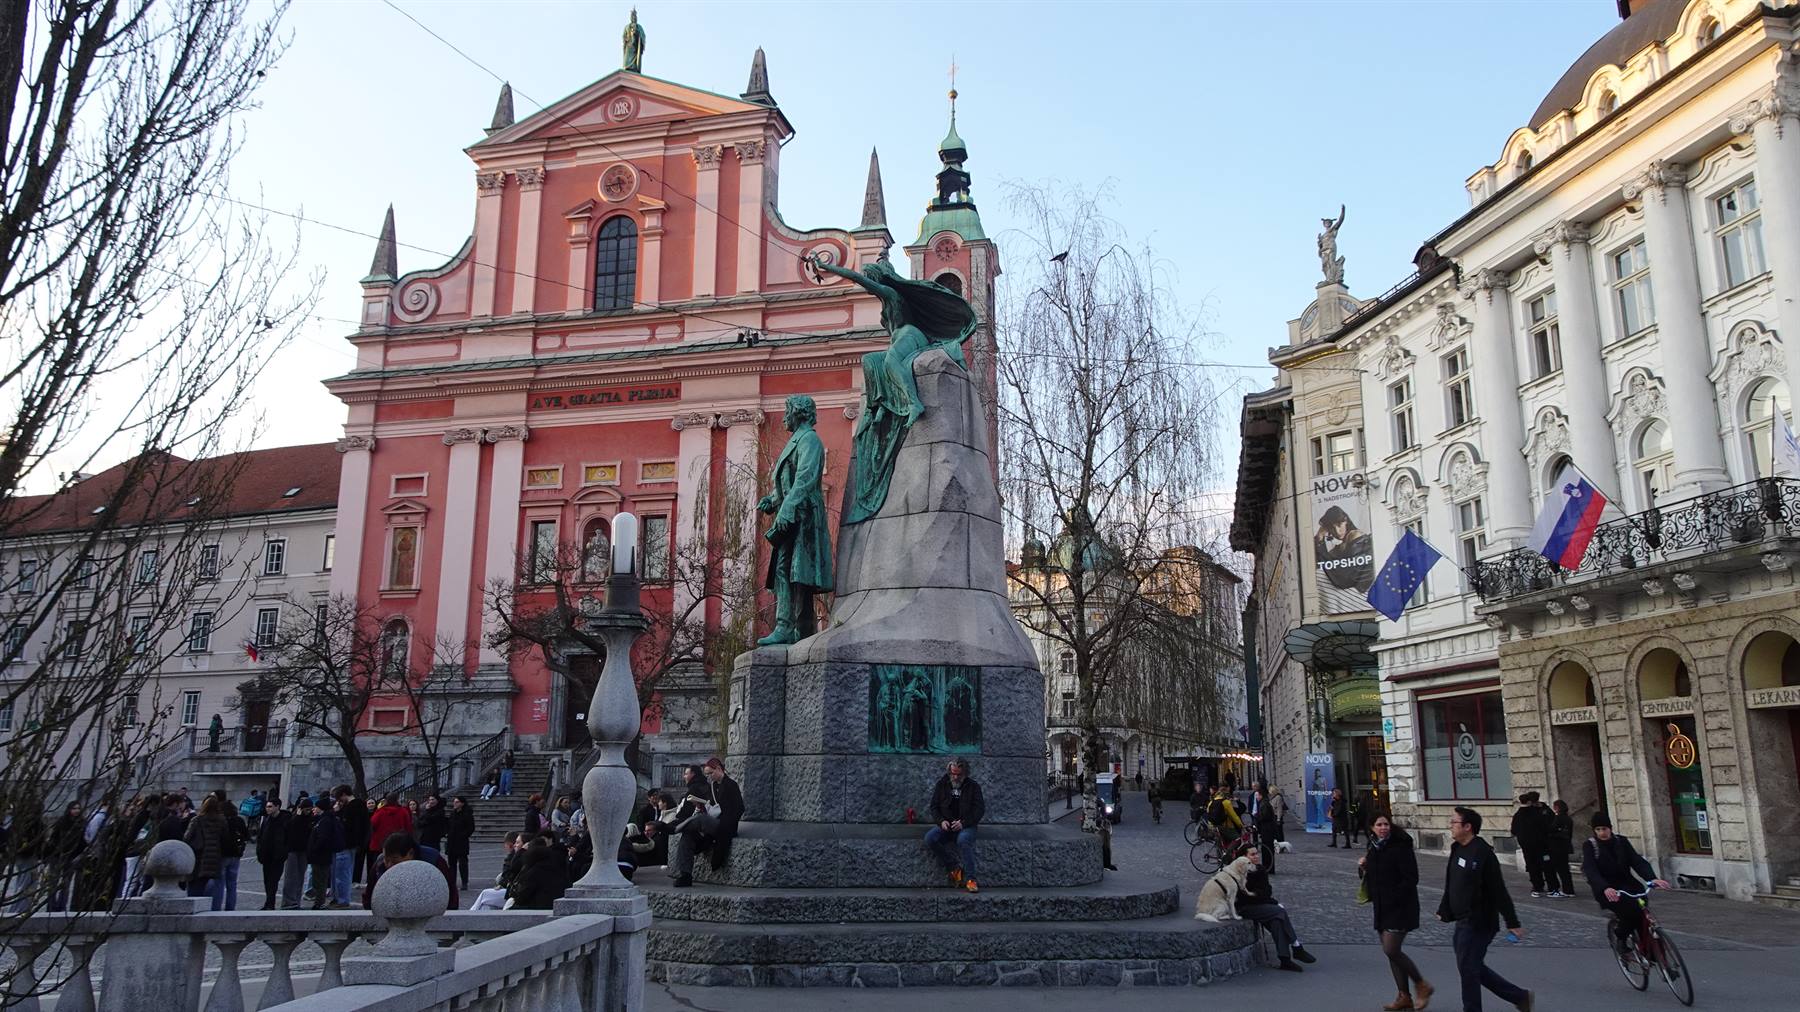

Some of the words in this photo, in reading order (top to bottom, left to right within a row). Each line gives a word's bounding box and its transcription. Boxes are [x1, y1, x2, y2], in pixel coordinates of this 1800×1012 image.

[569, 392, 622, 405] GRATIA
[1314, 474, 1364, 495] NOVO
[1317, 555, 1372, 571] TOPSHOP
[1642, 700, 1695, 713] CENTRALNA
[1555, 710, 1596, 722] APOTEKA
[1306, 754, 1332, 764] NOVO
